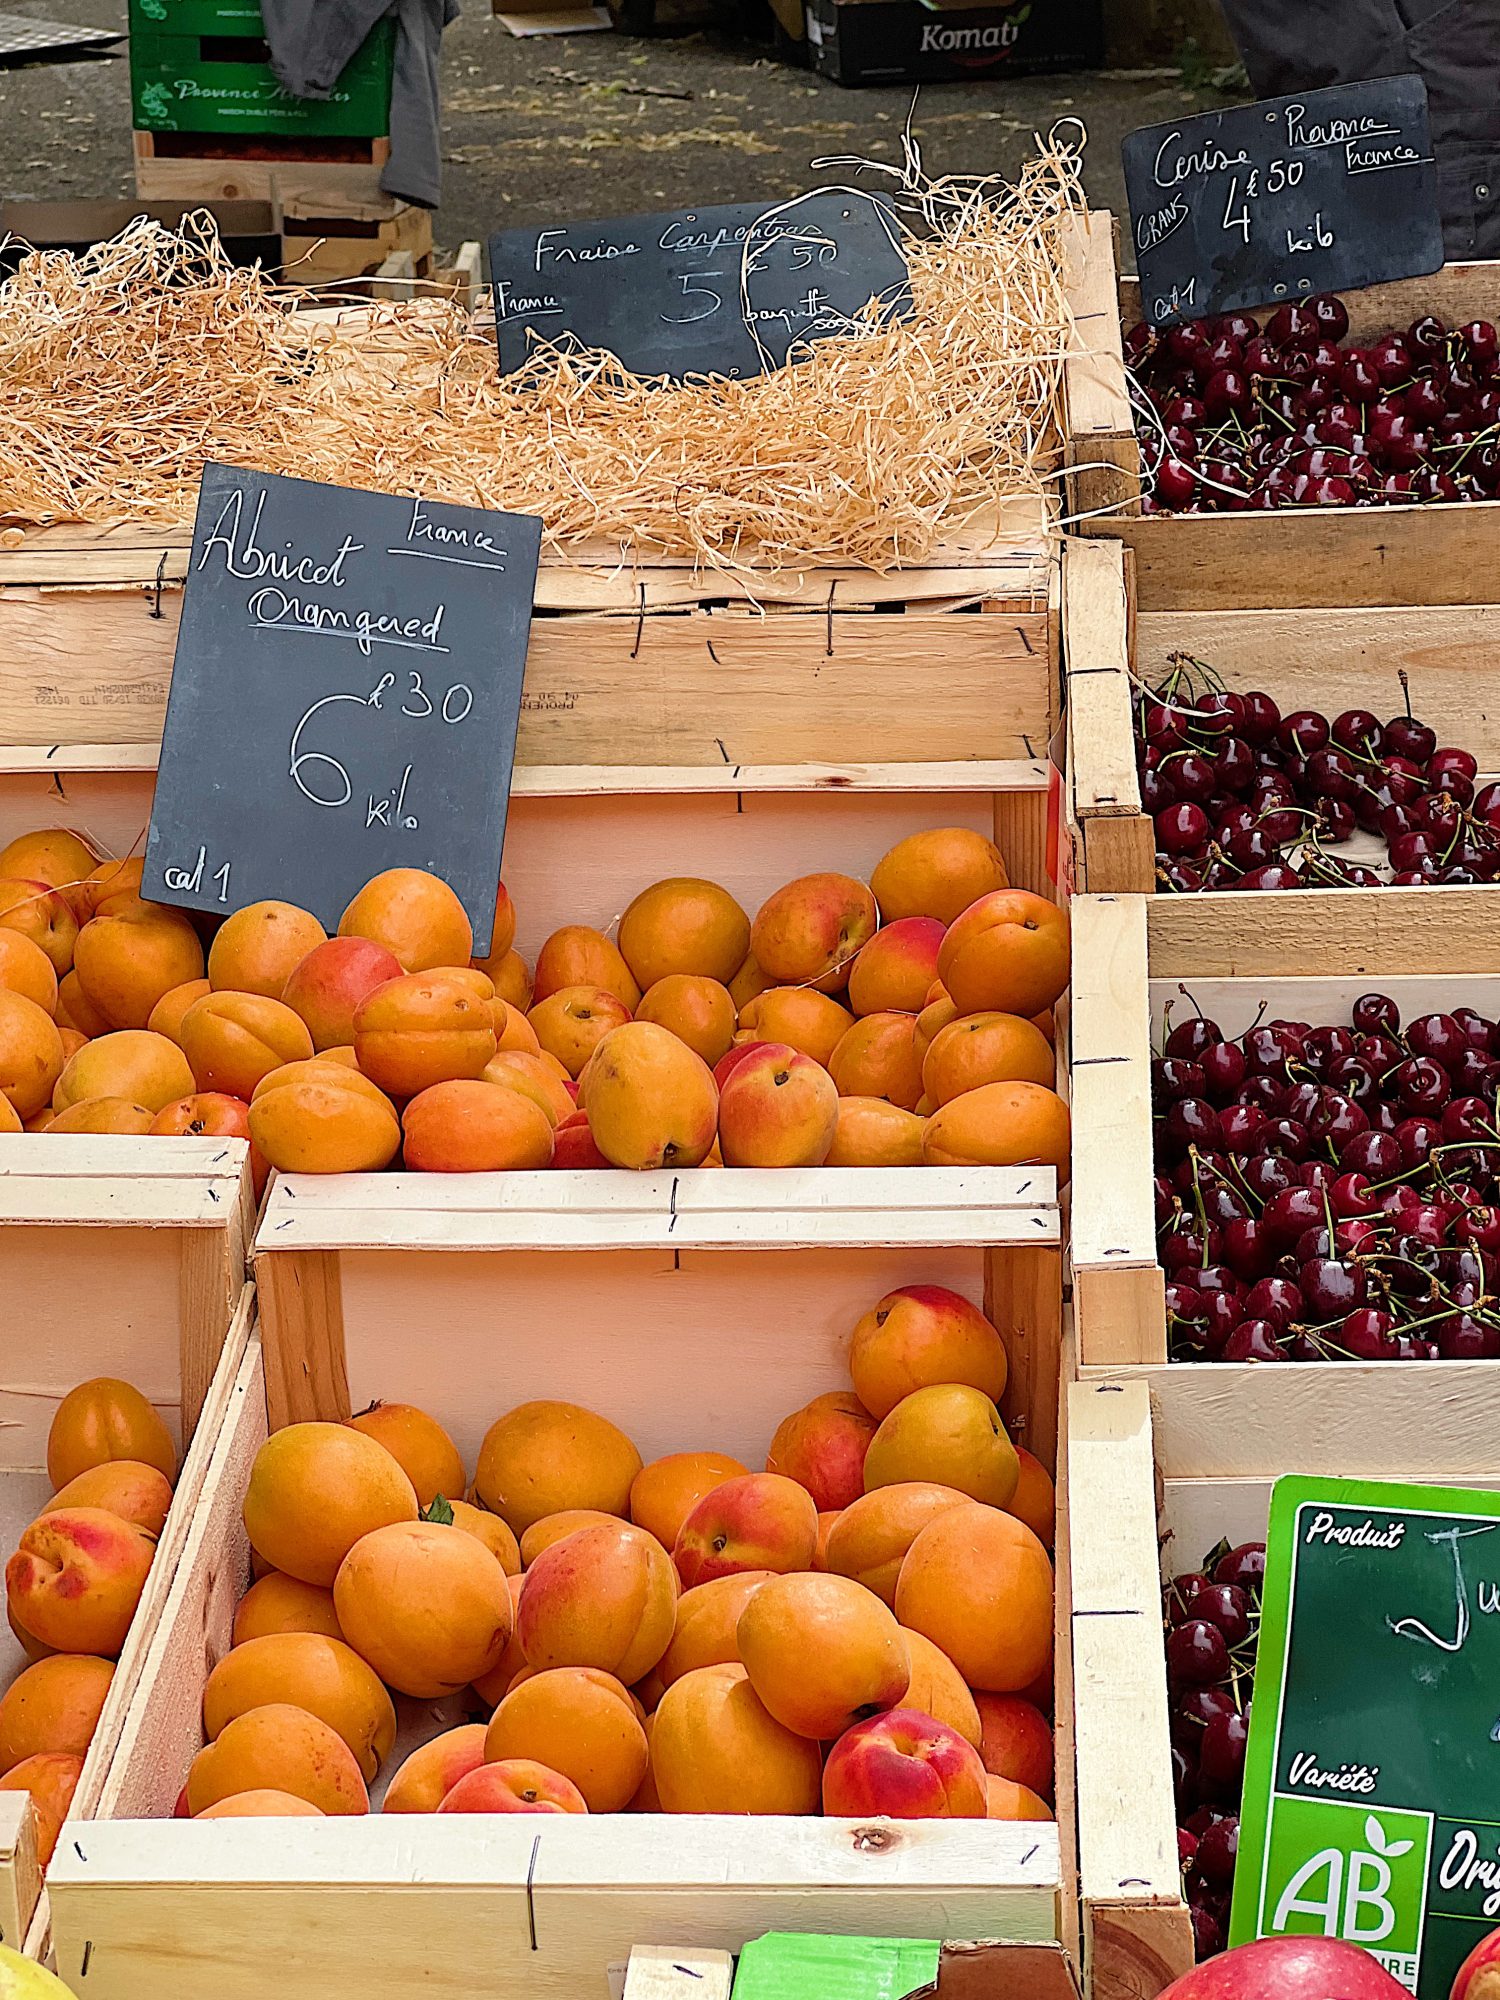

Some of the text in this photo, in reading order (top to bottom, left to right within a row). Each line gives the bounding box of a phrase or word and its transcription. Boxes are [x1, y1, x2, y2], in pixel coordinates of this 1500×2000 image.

[920, 24, 1019, 52] Komati
[174, 79, 260, 100] Provence
[1285, 104, 1388, 147] Provence
[1153, 131, 1252, 188] Cerise
[1346, 141, 1419, 170] France
[534, 217, 823, 271] Fraise Carpentras
[497, 281, 558, 317] France
[197, 489, 508, 587] Abricot France
[366, 764, 418, 829] kilo
[164, 845, 230, 902] cal 1
[1305, 1511, 1406, 1549] Produit
[1288, 1752, 1379, 1793] Variété
[1272, 1848, 1396, 1942] AB
